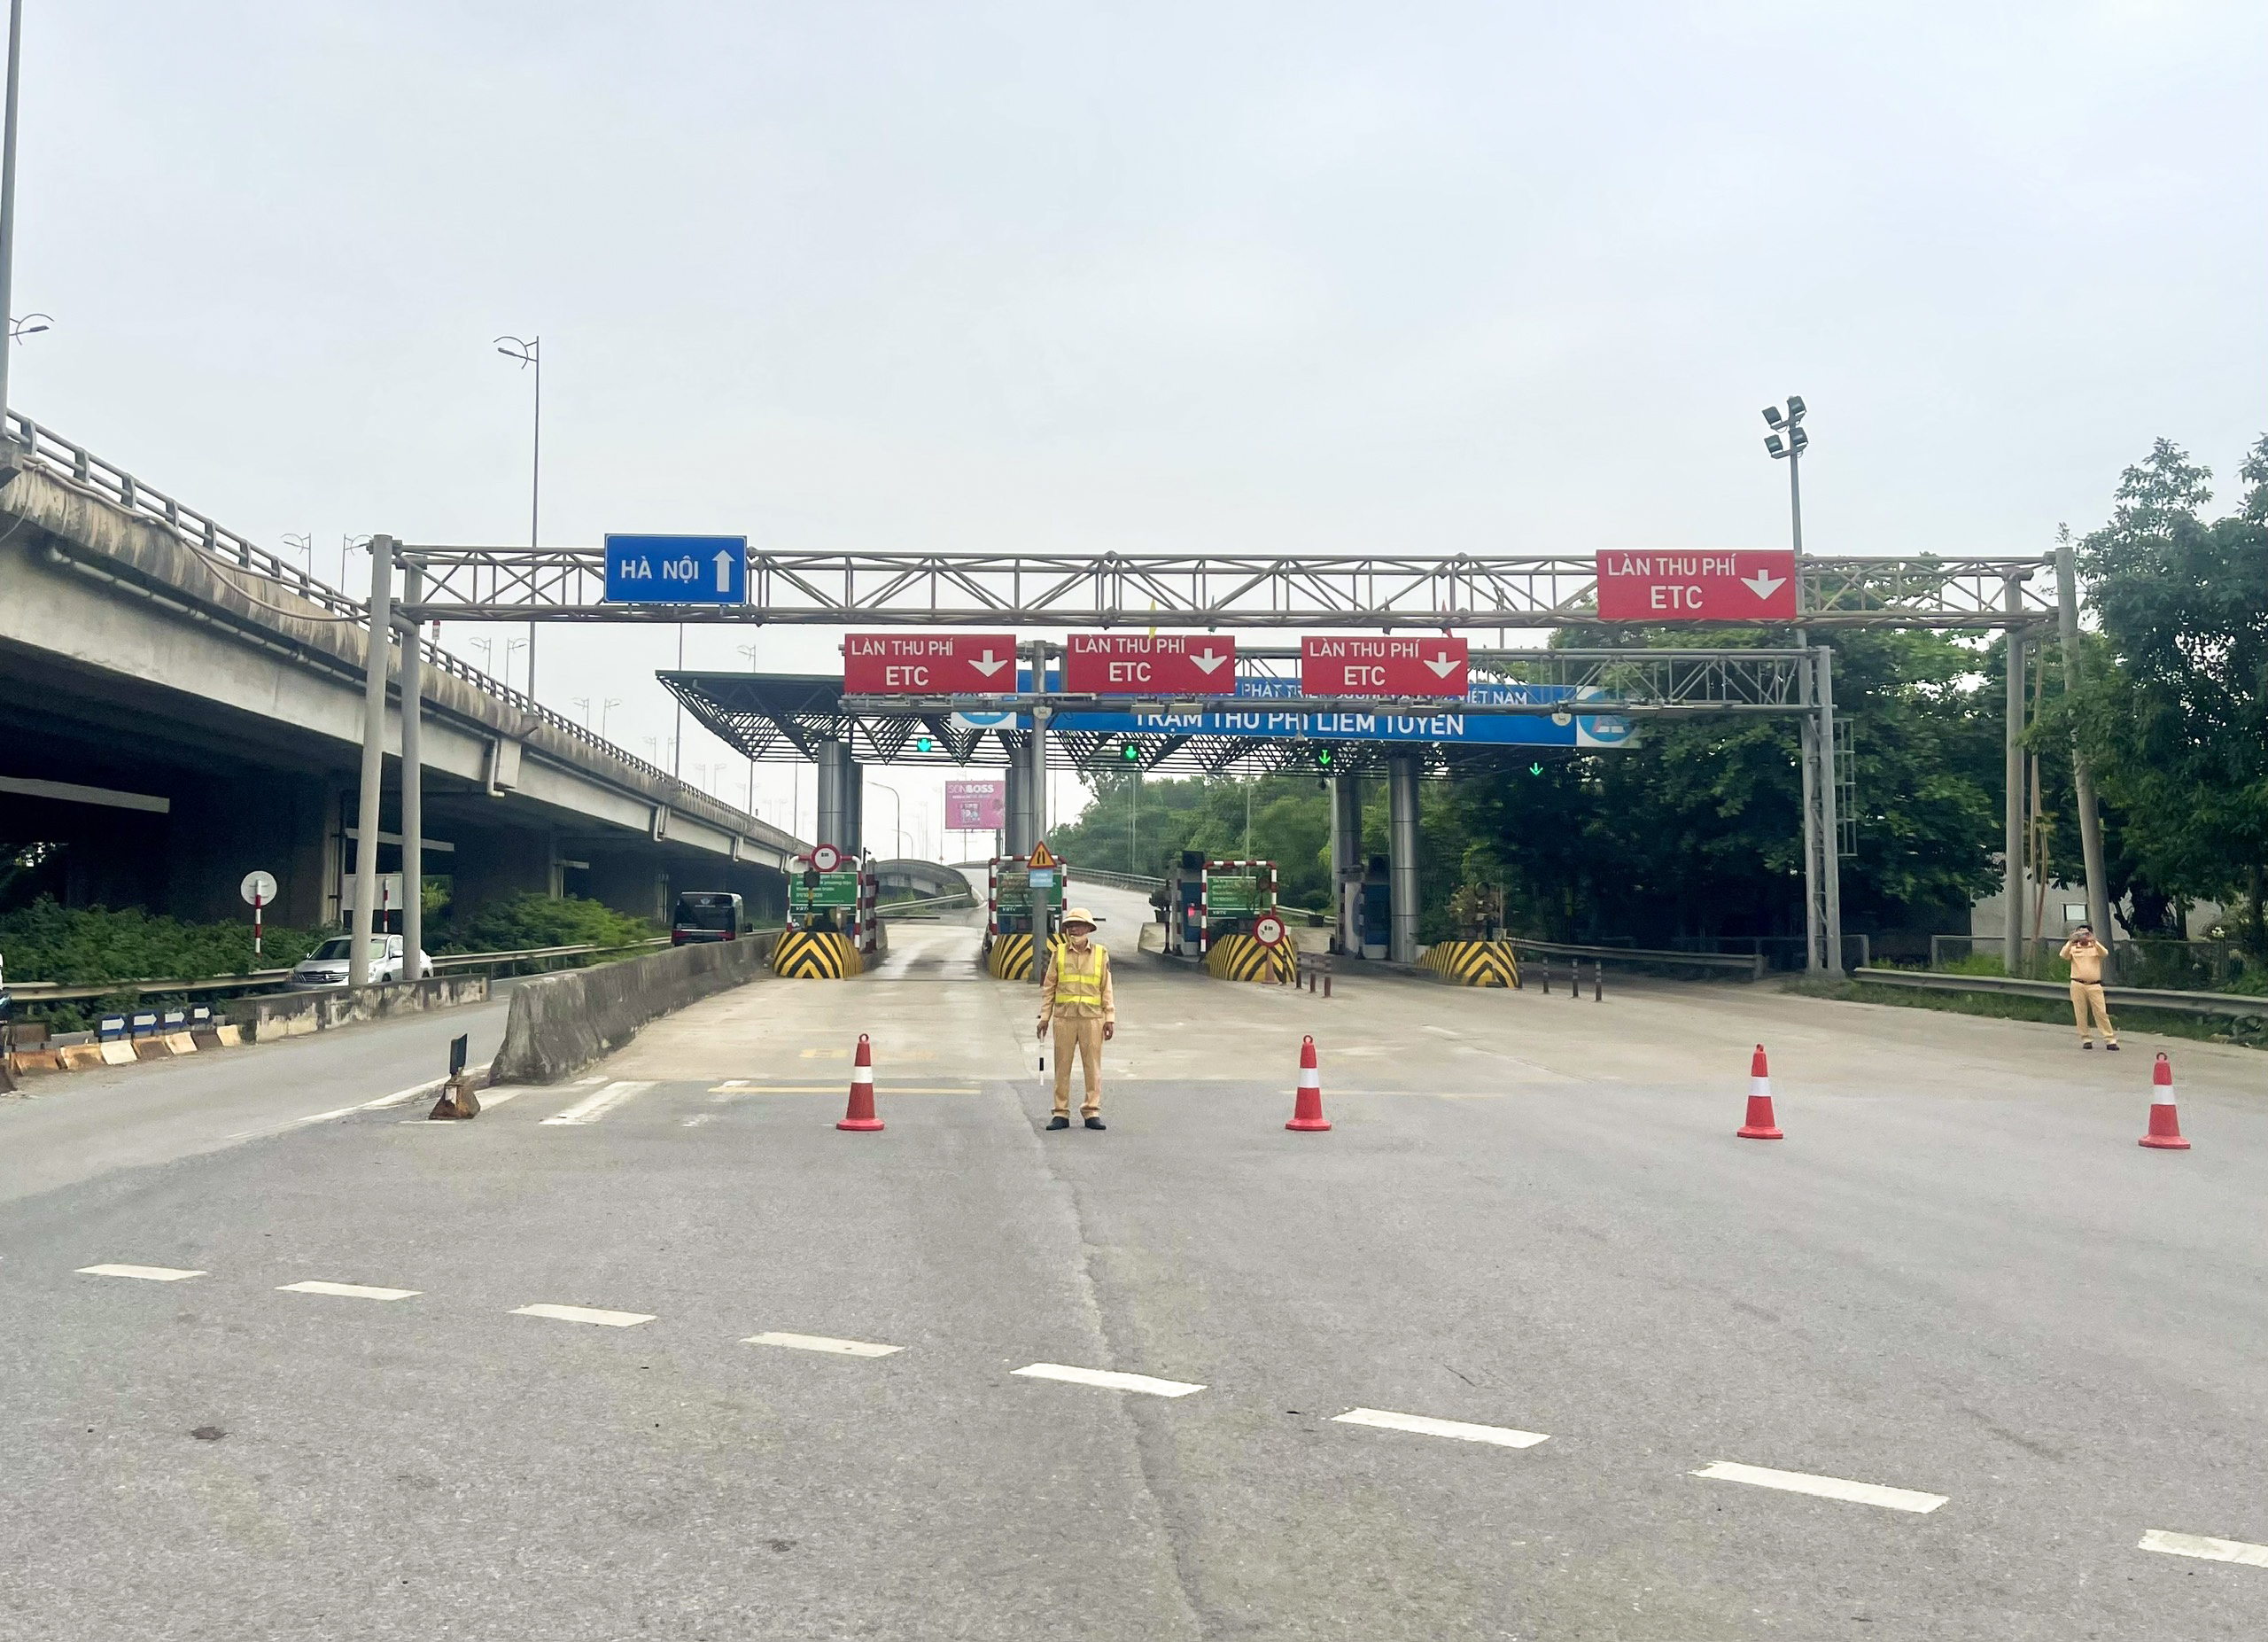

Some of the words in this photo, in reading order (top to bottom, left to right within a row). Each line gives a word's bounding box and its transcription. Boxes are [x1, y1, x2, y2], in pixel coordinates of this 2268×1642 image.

[621, 556, 653, 580] HÀ
[663, 555, 699, 584] NỘI
[1607, 553, 1651, 576] LÀN
[1655, 557, 1697, 576] THU
[1702, 553, 1736, 576] PHÍ
[1651, 585, 1704, 609] ETC
[851, 638, 885, 656] LÀN
[891, 640, 924, 656] THU
[928, 637, 953, 657] PHÍ
[1075, 634, 1110, 654] LÀN
[1115, 637, 1151, 654] THU
[1156, 634, 1185, 654] PHÍ
[1309, 637, 1345, 657] LÀN
[1350, 642, 1385, 658] THU
[1390, 639, 1420, 658] PHÍ
[886, 665, 928, 686] ETC
[1109, 662, 1152, 682] ETC
[1344, 665, 1386, 686] ETC
[1493, 690, 1527, 704] NAM
